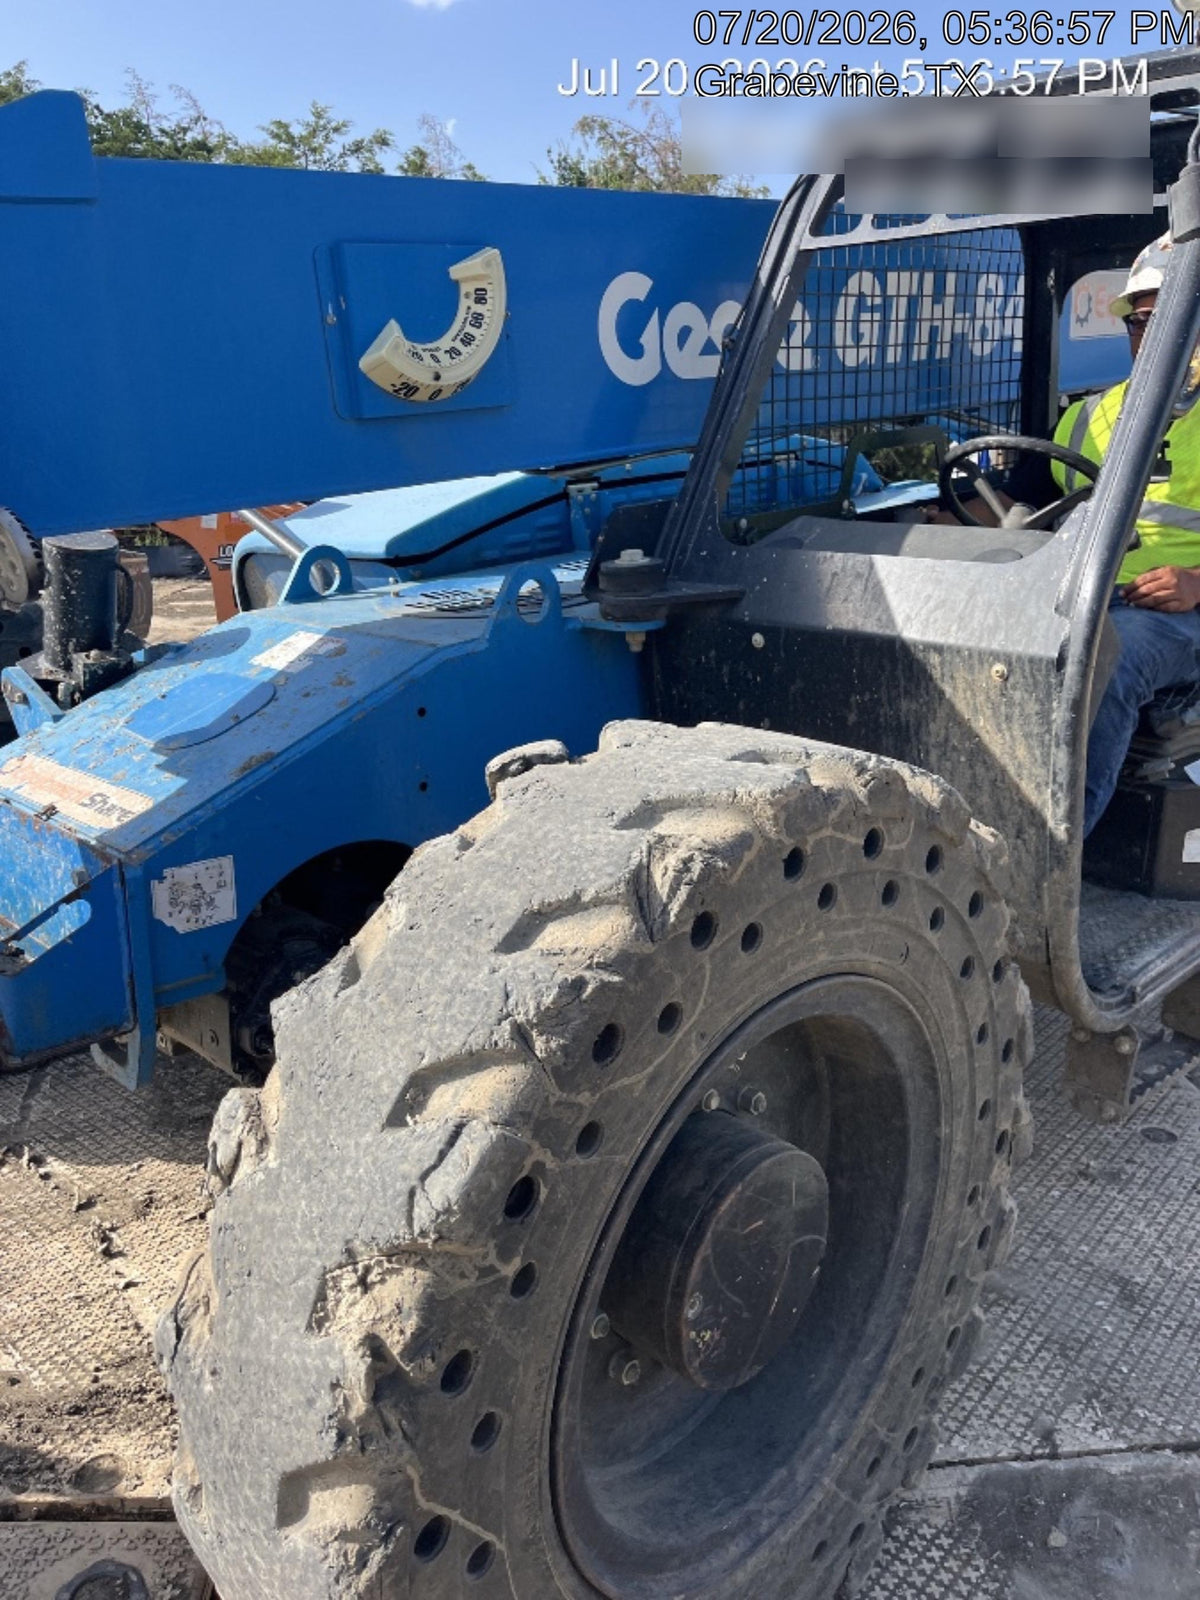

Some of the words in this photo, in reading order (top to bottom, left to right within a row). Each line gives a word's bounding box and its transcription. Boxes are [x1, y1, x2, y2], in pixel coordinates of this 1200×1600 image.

[444, 346, 462, 360] 20
[460, 332, 476, 347] 40
[469, 312, 485, 329] 60
[598, 271, 813, 387] Gee
[390, 381, 420, 400] -20
